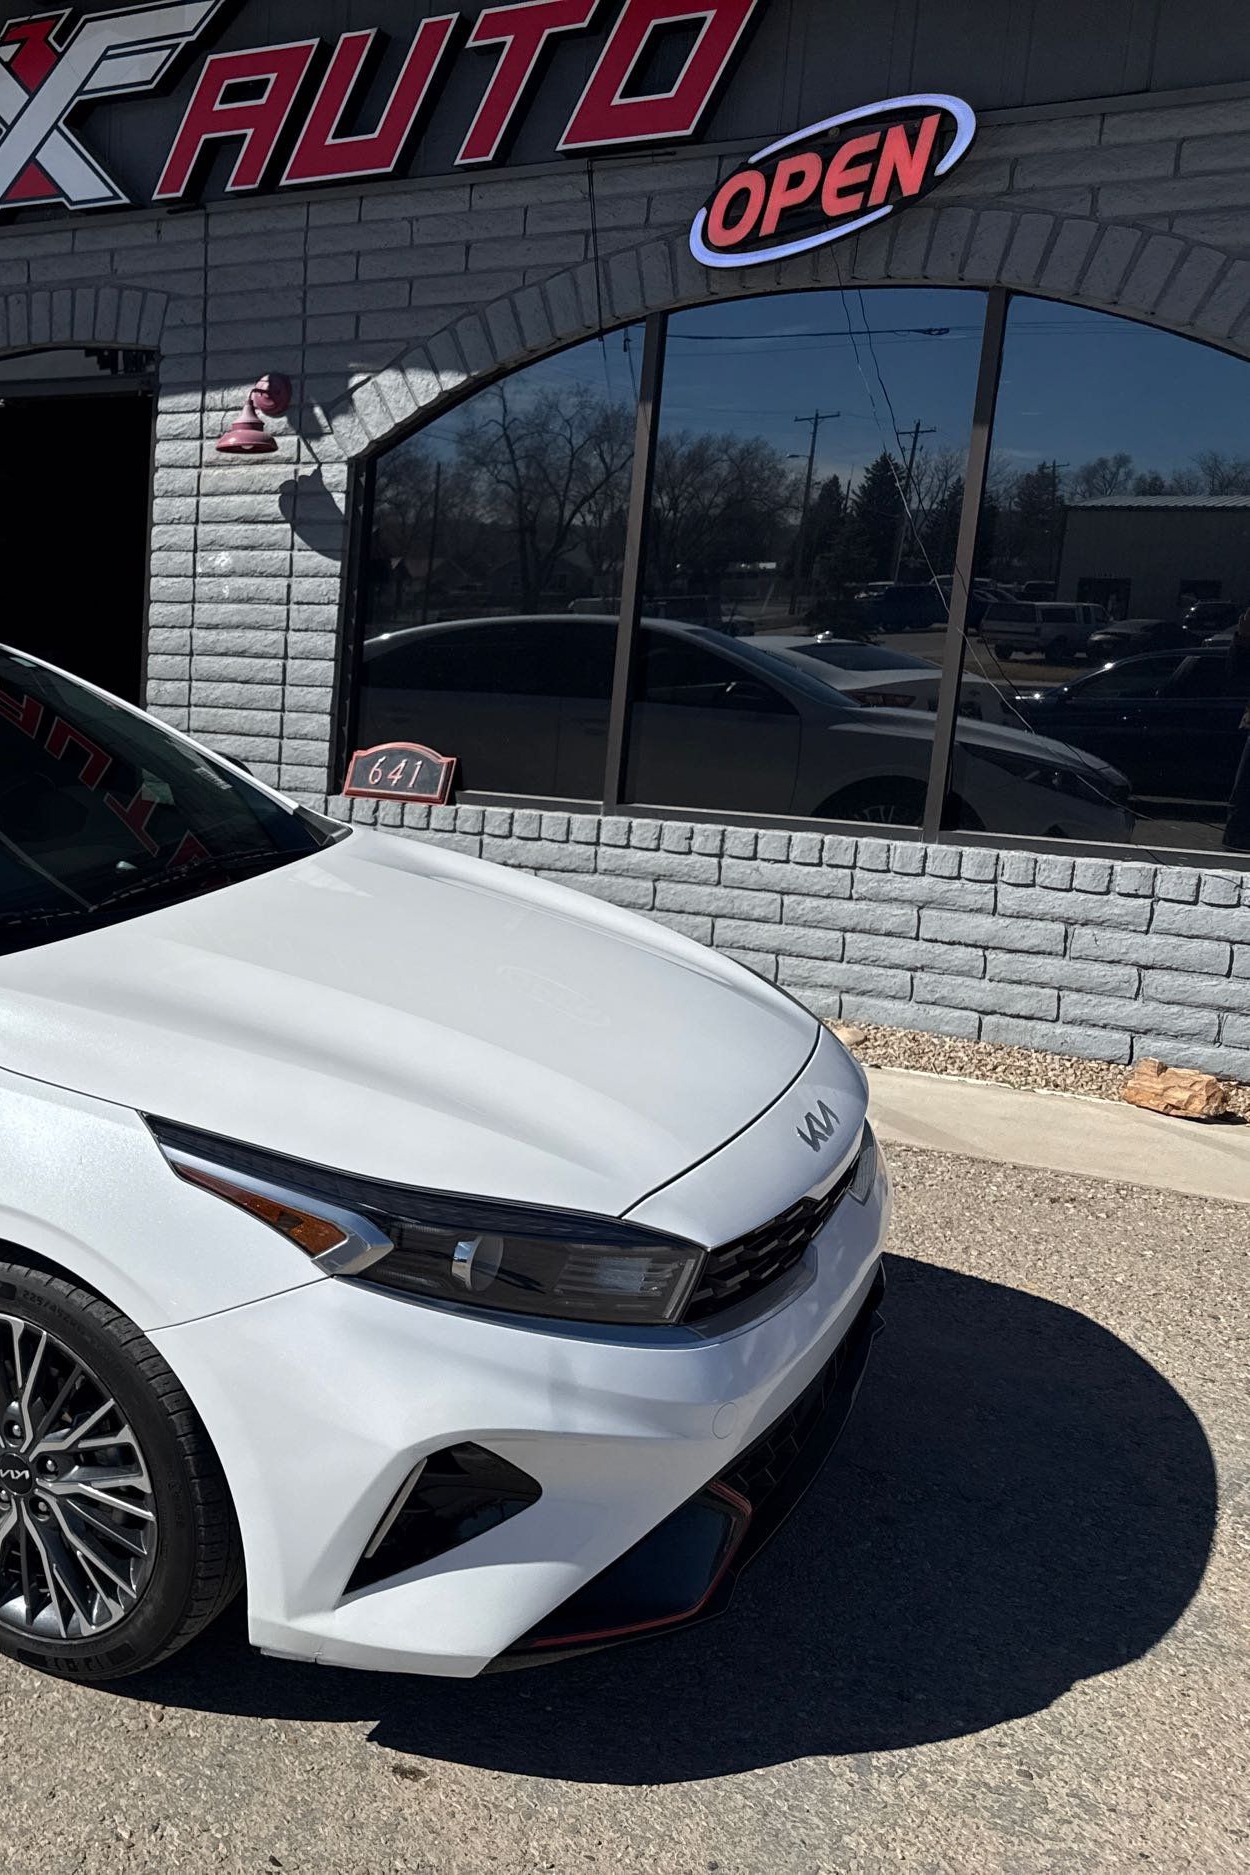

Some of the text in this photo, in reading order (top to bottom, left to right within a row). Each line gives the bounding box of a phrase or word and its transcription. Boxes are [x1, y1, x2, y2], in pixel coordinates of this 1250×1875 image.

[152, 0, 759, 200] AUTO
[707, 114, 941, 249] OPEN
[368, 756, 424, 788] 641
